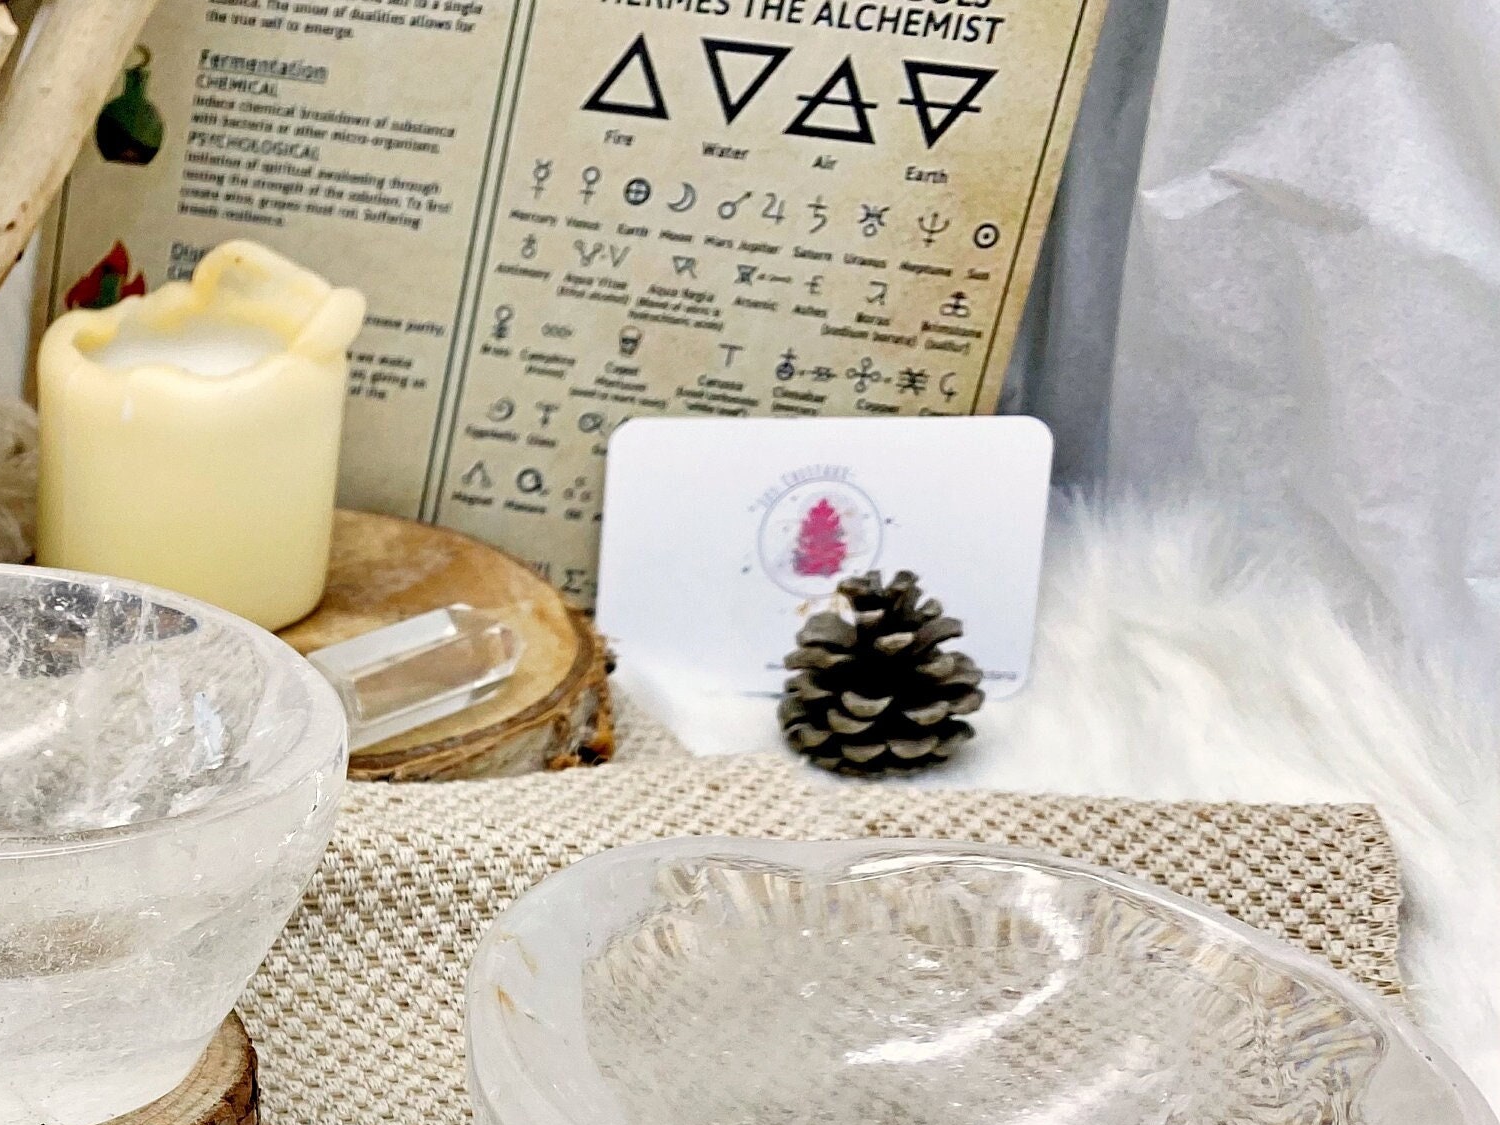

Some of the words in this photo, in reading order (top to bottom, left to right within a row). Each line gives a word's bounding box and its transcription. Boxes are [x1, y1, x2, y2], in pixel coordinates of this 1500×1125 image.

[409, 15, 453, 30] allows
[812, 1, 1007, 45] ALCHEMIST
[198, 48, 329, 81] Fermentation
[194, 73, 278, 98] CHEMICAL
[187, 129, 321, 162] PSYCHOLOGICAL
[604, 129, 636, 147] Fire
[702, 140, 751, 161] Water
[811, 155, 840, 171] Air
[904, 165, 949, 185] Earth
[616, 223, 650, 238] Earth
